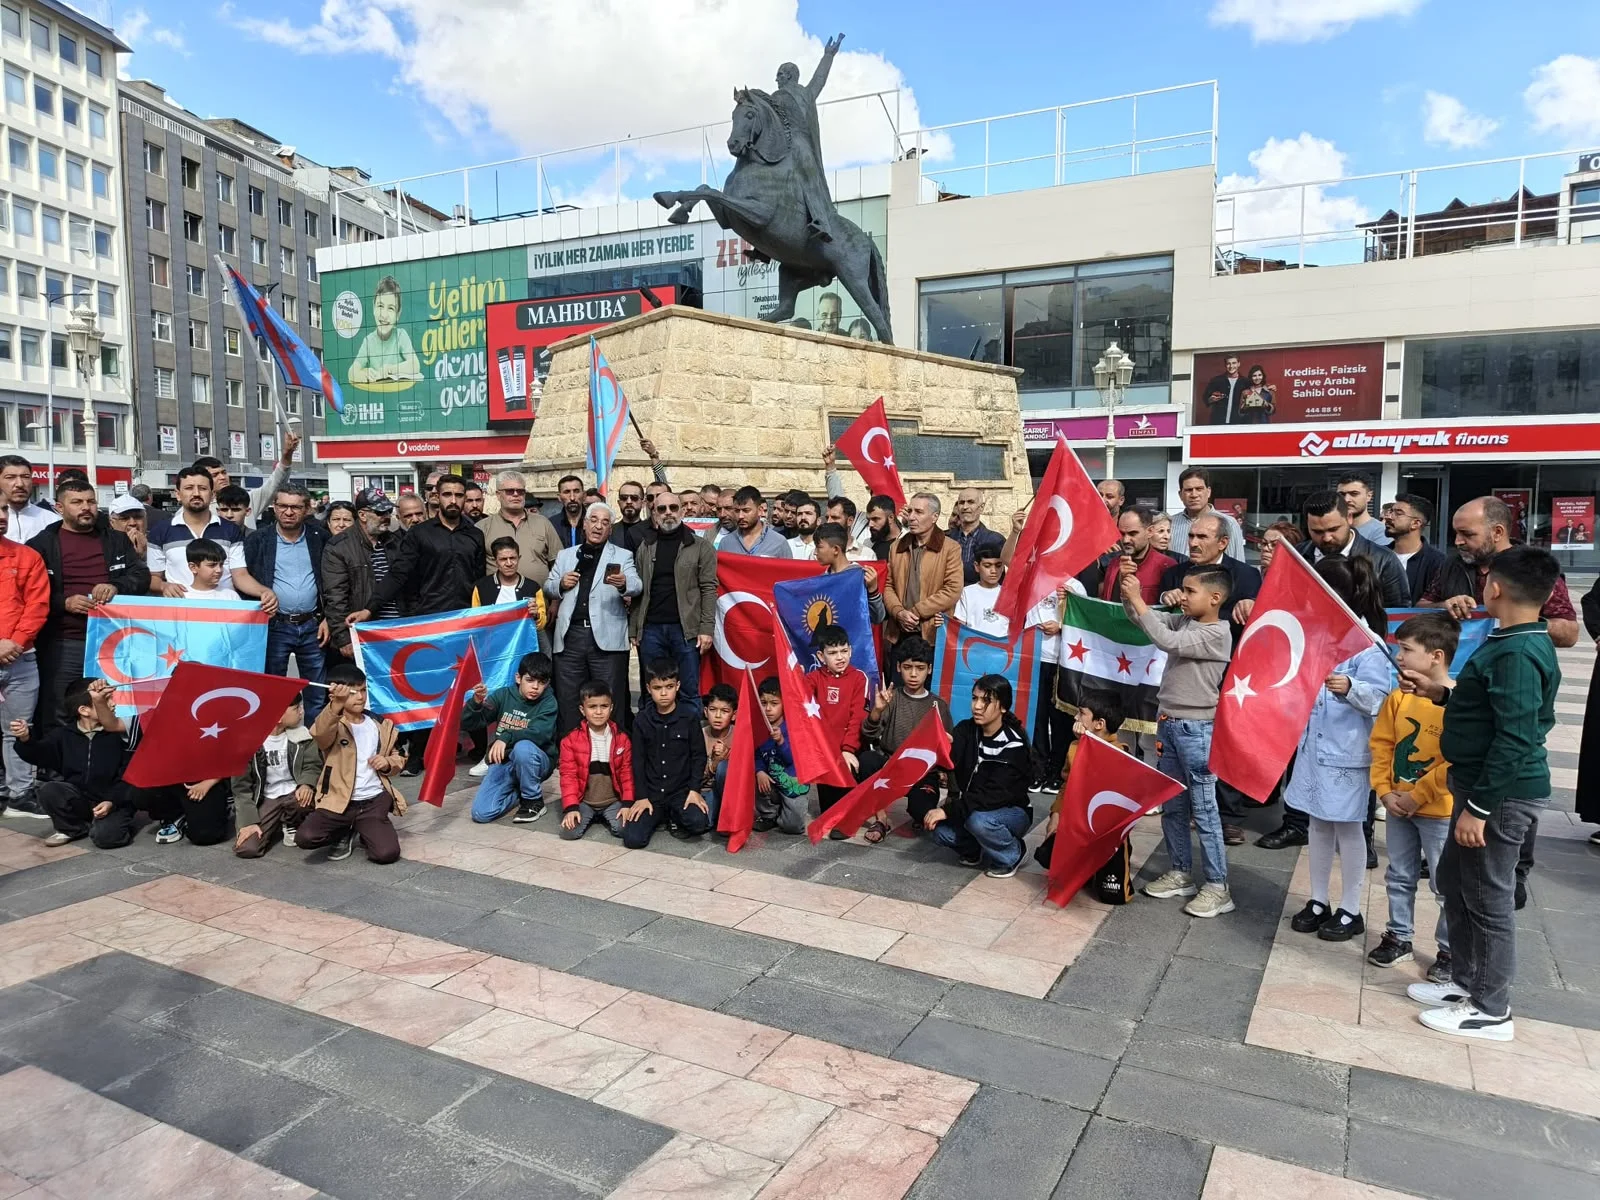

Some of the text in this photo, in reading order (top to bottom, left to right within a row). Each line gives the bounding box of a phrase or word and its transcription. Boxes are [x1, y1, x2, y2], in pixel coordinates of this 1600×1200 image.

[566, 248, 587, 266] HER
[589, 243, 629, 262] ZAMAN
[632, 240, 654, 258] HER
[657, 234, 694, 254] YERDE
[429, 276, 506, 320] Yetim
[1284, 364, 1367, 377] Kredisiz, Faizsiz
[1294, 379, 1306, 387] Ev
[1324, 377, 1355, 385] Araba
[1293, 387, 1356, 398] Sahibi Olun.
[408, 443, 440, 452] vodafone
[1332, 431, 1509, 454] albayrak finans
